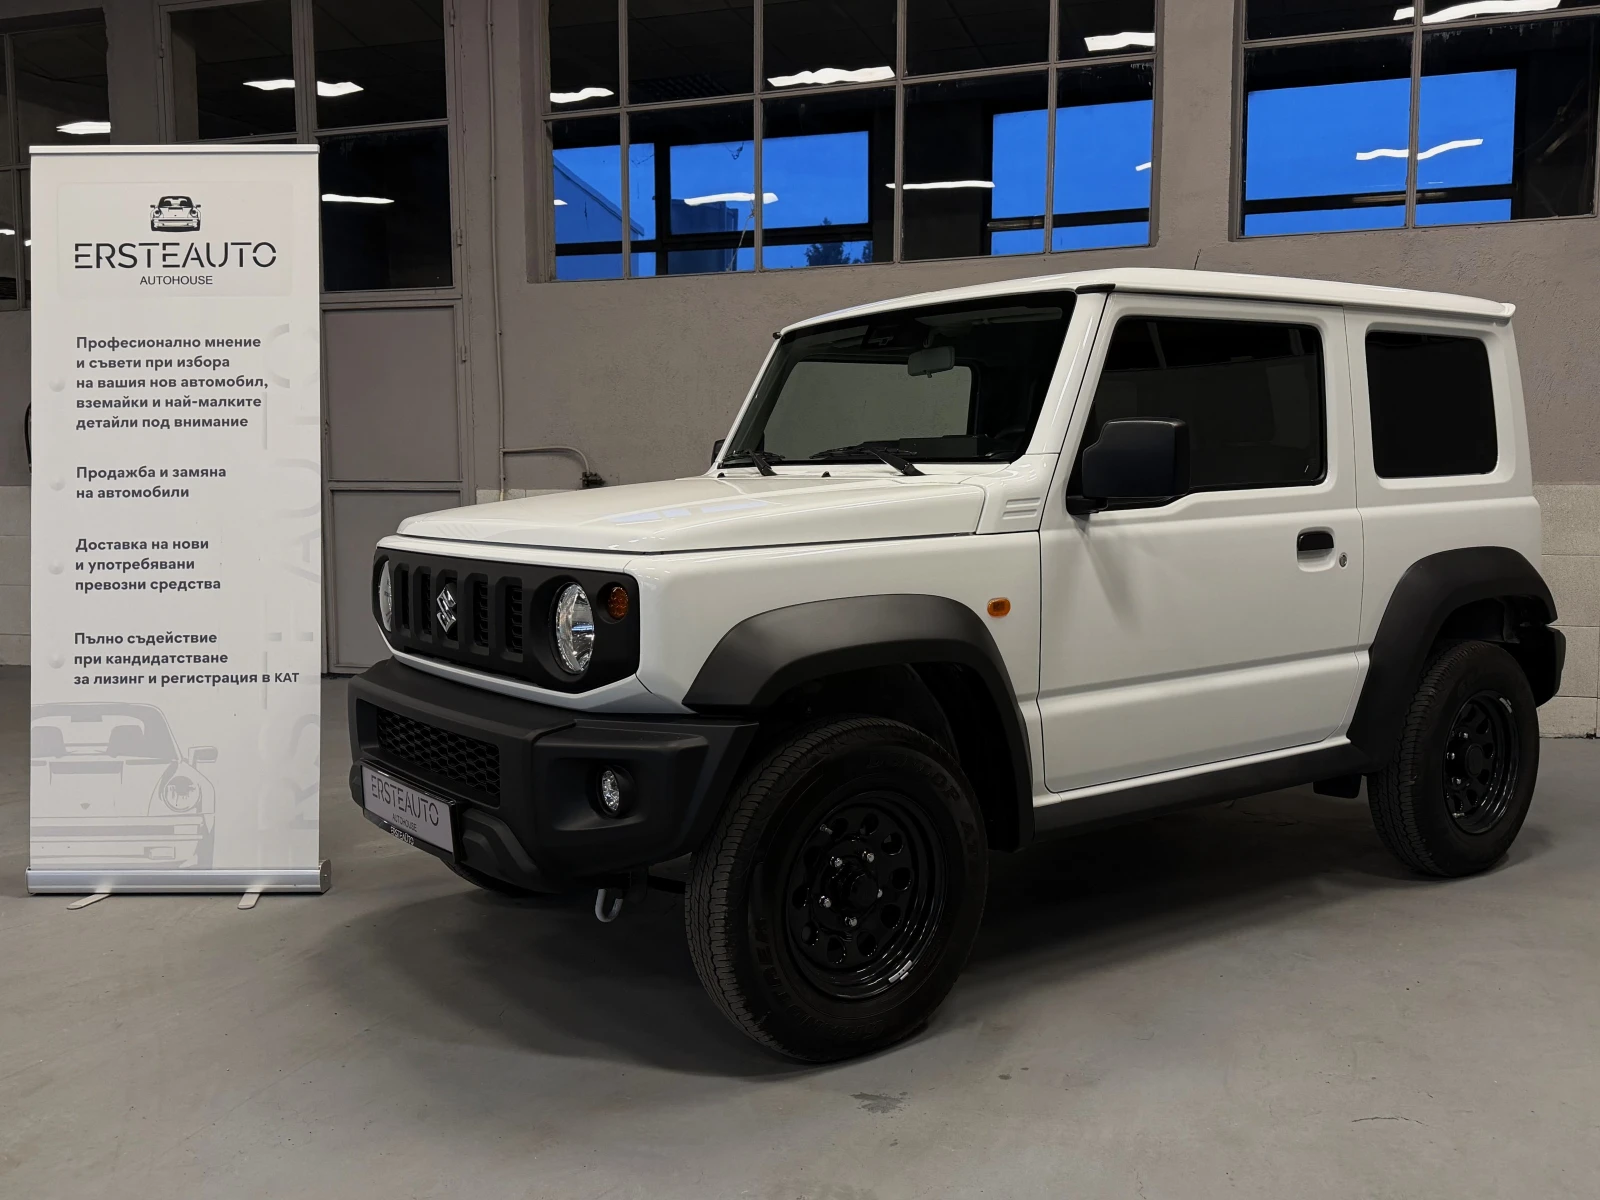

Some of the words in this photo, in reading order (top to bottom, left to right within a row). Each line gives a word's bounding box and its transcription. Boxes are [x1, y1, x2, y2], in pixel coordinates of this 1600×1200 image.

[75, 242, 276, 268] ERSTEAUTO
[140, 276, 213, 285] AUTOHOUSE
[76, 336, 201, 353] Професионално
[204, 338, 262, 348] мнение
[76, 359, 85, 369] и
[88, 359, 142, 369] съвети
[145, 358, 173, 372] при
[176, 355, 230, 371] избора
[76, 379, 94, 389] на
[97, 379, 146, 389] вашия
[149, 378, 177, 388] нов
[180, 374, 269, 390] автомобил,
[76, 395, 149, 409] вземайки
[152, 398, 161, 408] и
[164, 394, 262, 408] най-малките
[75, 415, 138, 431] детайли
[142, 418, 171, 430] под
[174, 418, 249, 428] внимание
[76, 465, 156, 483] Продажба
[159, 468, 169, 478] и
[172, 468, 227, 478] замяна
[76, 489, 94, 499] на
[97, 485, 190, 499] автомобили
[75, 538, 148, 553] Доставка
[151, 540, 169, 550] на
[172, 540, 209, 550] нови
[75, 561, 84, 571] и
[87, 557, 195, 575] употребявани
[75, 580, 147, 595] превозни
[149, 580, 221, 594] средства
[74, 632, 124, 645] Пълно
[126, 630, 218, 647] съдействие
[74, 655, 102, 669] при
[105, 654, 229, 667] кандидатстване
[73, 675, 90, 685] за
[93, 675, 145, 685] лизинг
[148, 675, 157, 684] и
[160, 674, 258, 688] регистрация
[261, 673, 271, 683] в
[274, 672, 300, 683] КАТ
[370, 774, 440, 827] ERSTEAUTO
